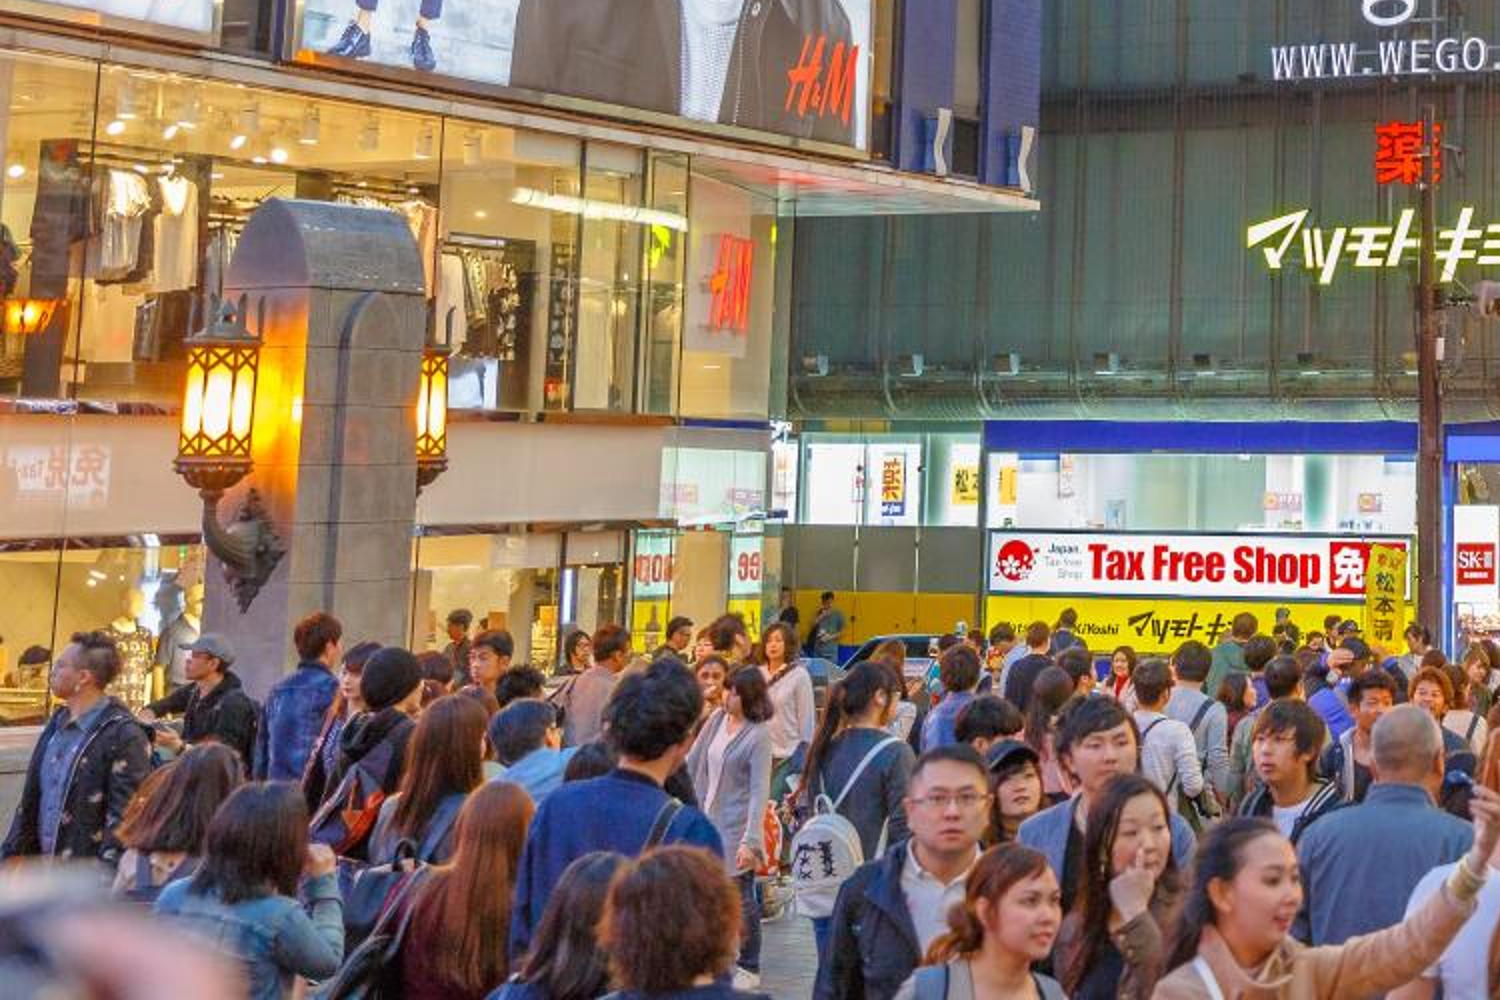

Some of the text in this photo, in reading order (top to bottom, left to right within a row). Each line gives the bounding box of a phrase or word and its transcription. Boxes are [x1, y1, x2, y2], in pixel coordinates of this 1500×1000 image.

[784, 33, 859, 128] H&M
[1374, 120, 1443, 185] 薬
[1087, 543, 1321, 589] Tax Free Shop
[1332, 546, 1370, 590] 免
[1127, 610, 1233, 645] マツモトキ
